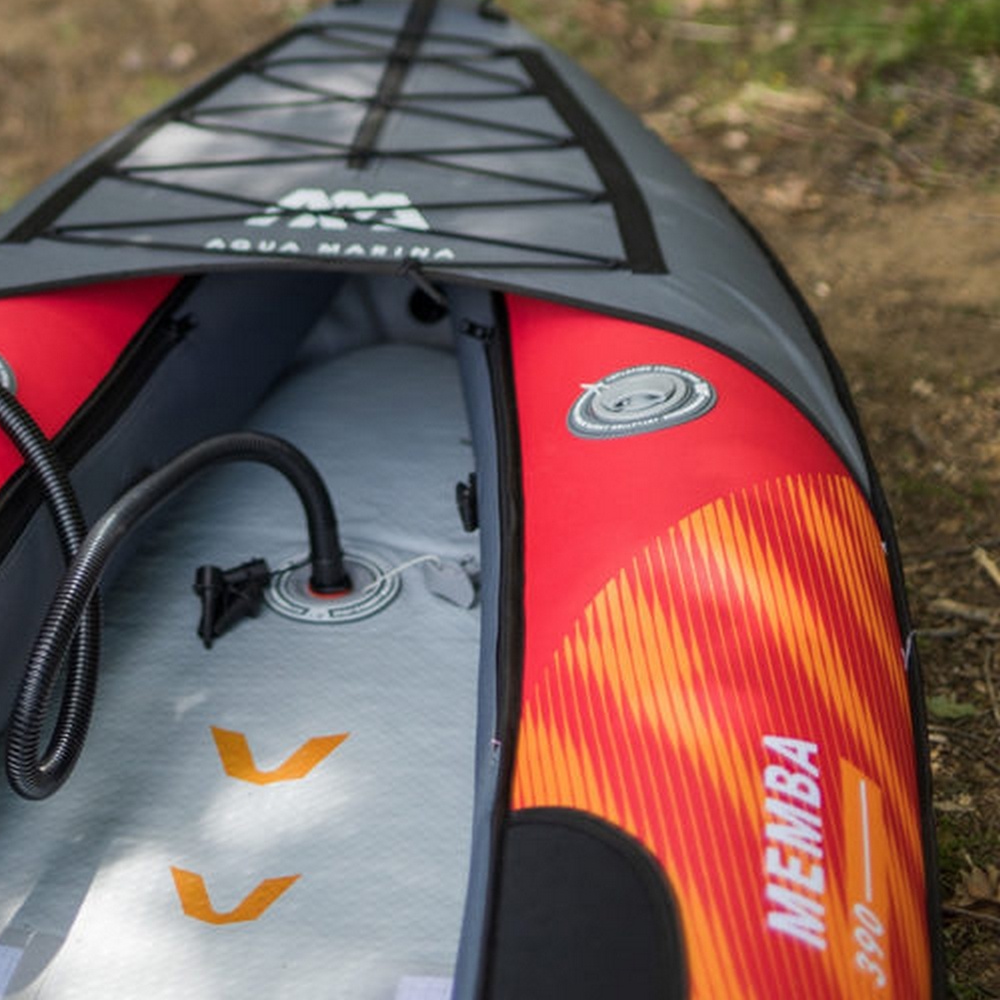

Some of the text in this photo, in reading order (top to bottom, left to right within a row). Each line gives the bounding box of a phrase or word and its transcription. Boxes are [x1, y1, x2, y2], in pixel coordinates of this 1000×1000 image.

[204, 237, 456, 260] AQUA MARINA
[763, 735, 827, 951] MEMBA
[851, 902, 887, 988] 390
